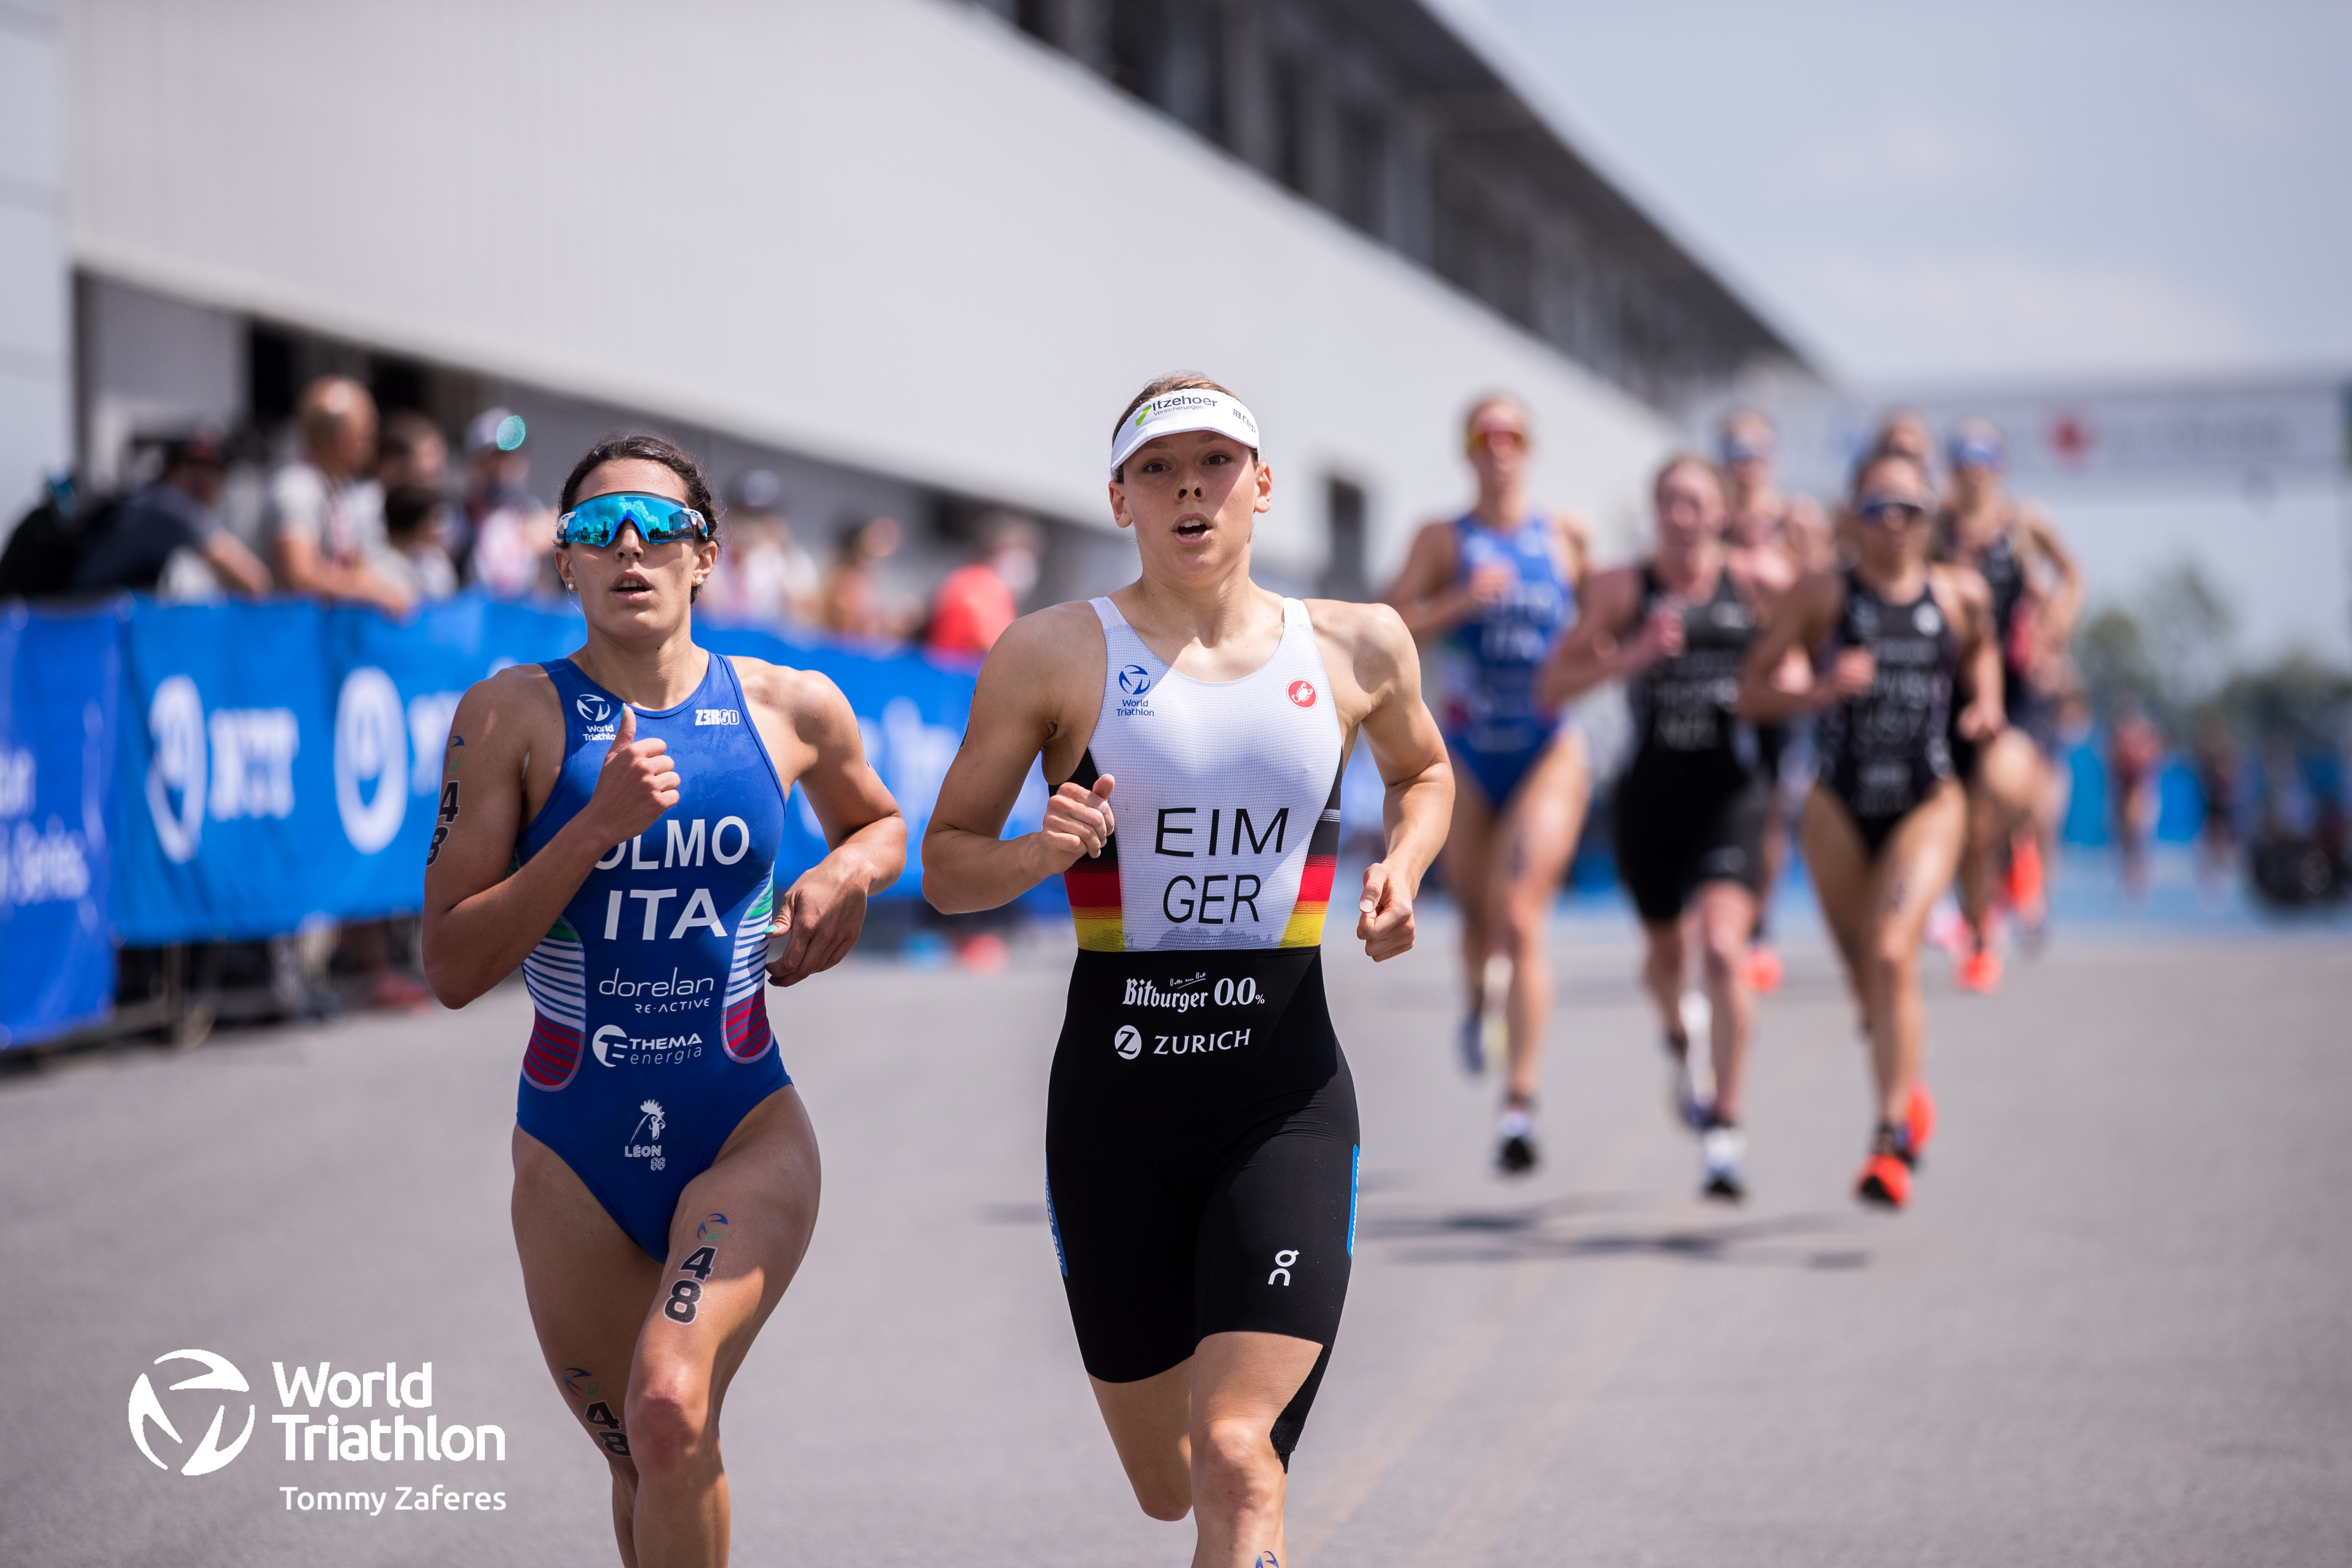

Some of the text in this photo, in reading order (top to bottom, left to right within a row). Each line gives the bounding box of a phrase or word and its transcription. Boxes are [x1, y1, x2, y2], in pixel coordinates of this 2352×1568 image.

[1152, 396, 1217, 411] Itzehoer
[1154, 405, 1204, 416] Versicherungen
[1116, 708, 1155, 717] Triathlon
[582, 732, 616, 741] Triathlo
[587, 724, 614, 732] World
[1155, 807, 1289, 858] EIM
[1163, 874, 1261, 924] GER
[604, 888, 728, 940] ITA
[599, 967, 714, 996] dorelan
[1122, 978, 1208, 1013] Bitburger
[629, 1033, 703, 1050] THEMA
[1154, 1029, 1251, 1055] ZURICH
[630, 1044, 702, 1065] energia
[663, 1245, 718, 1325] 48
